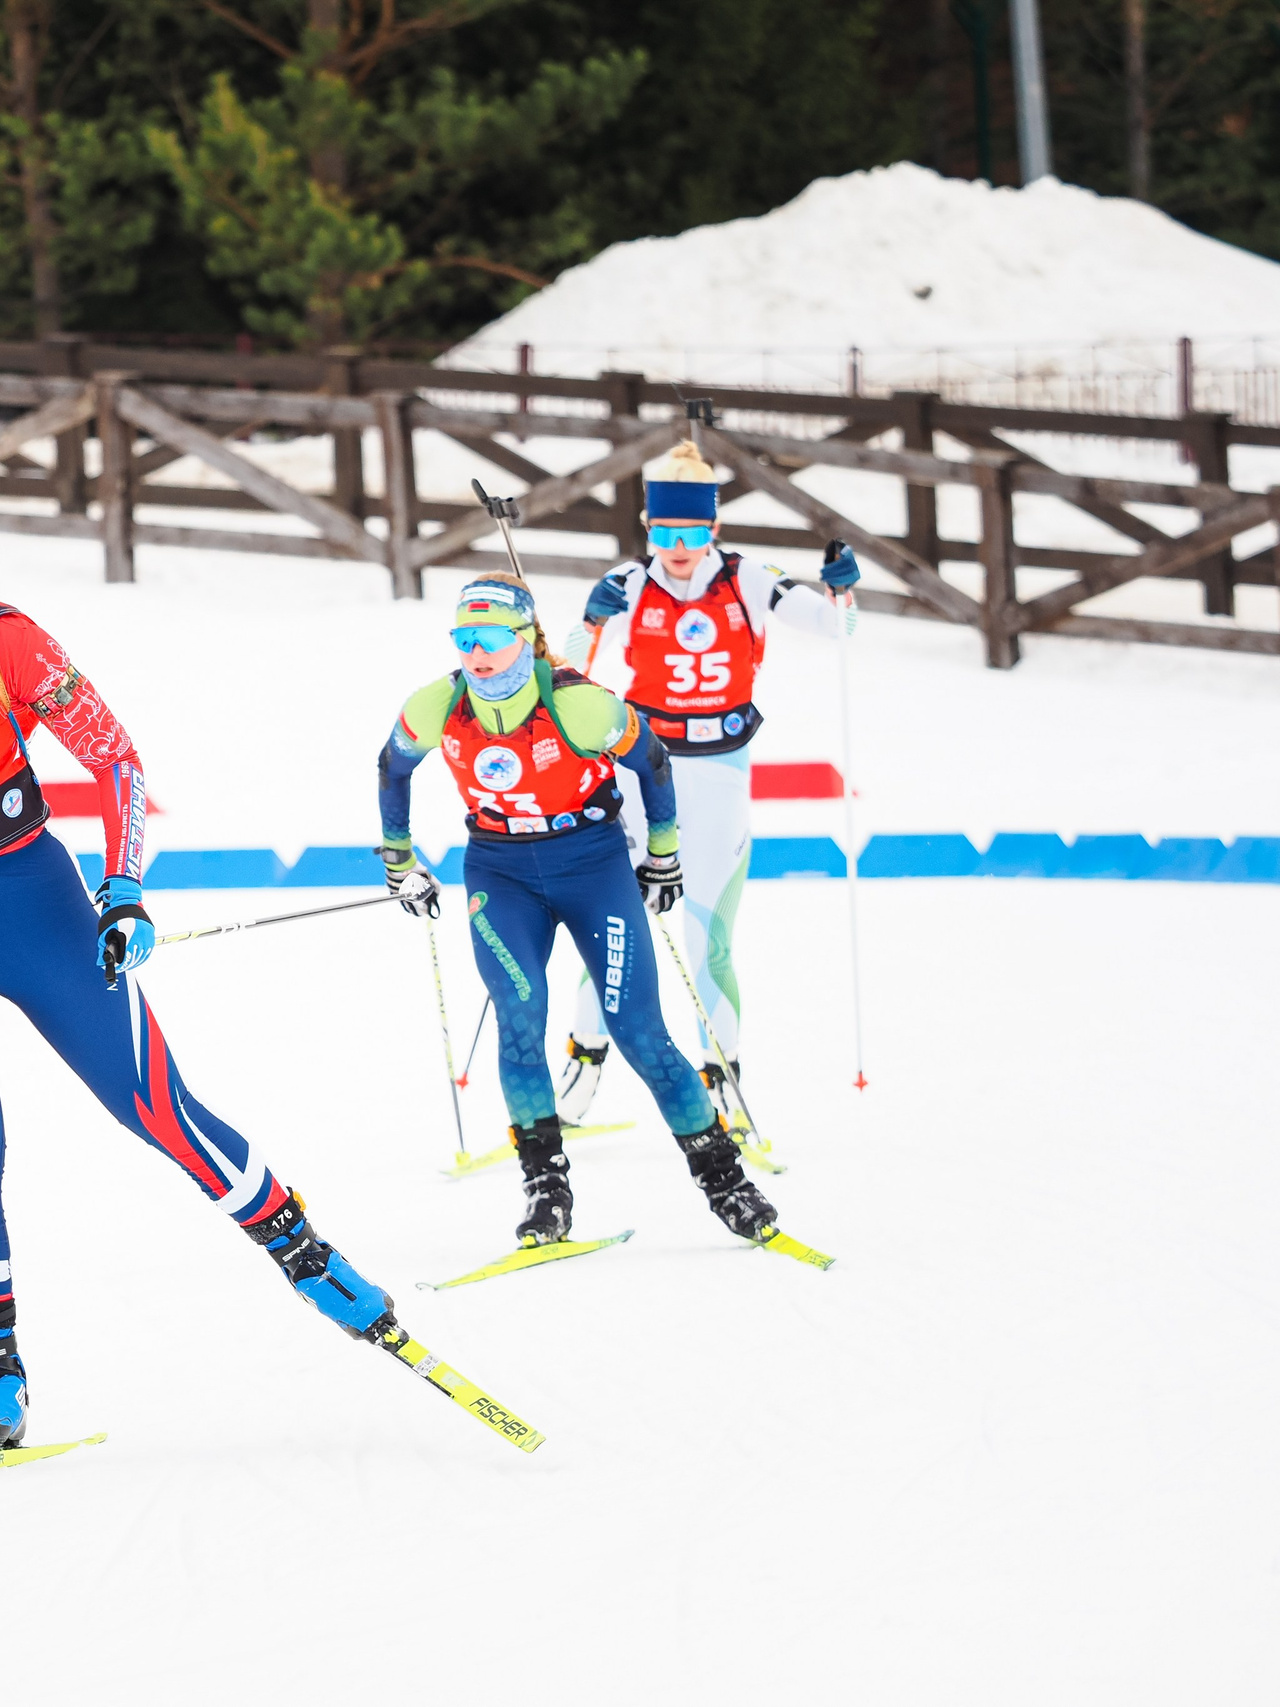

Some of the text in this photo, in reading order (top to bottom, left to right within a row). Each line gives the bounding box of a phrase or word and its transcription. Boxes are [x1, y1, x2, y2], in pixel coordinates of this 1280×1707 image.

[664, 651, 731, 694] 35
[271, 1209, 293, 1230] 176
[282, 1238, 311, 1263] SPINE
[469, 1397, 529, 1441] FISCHER
